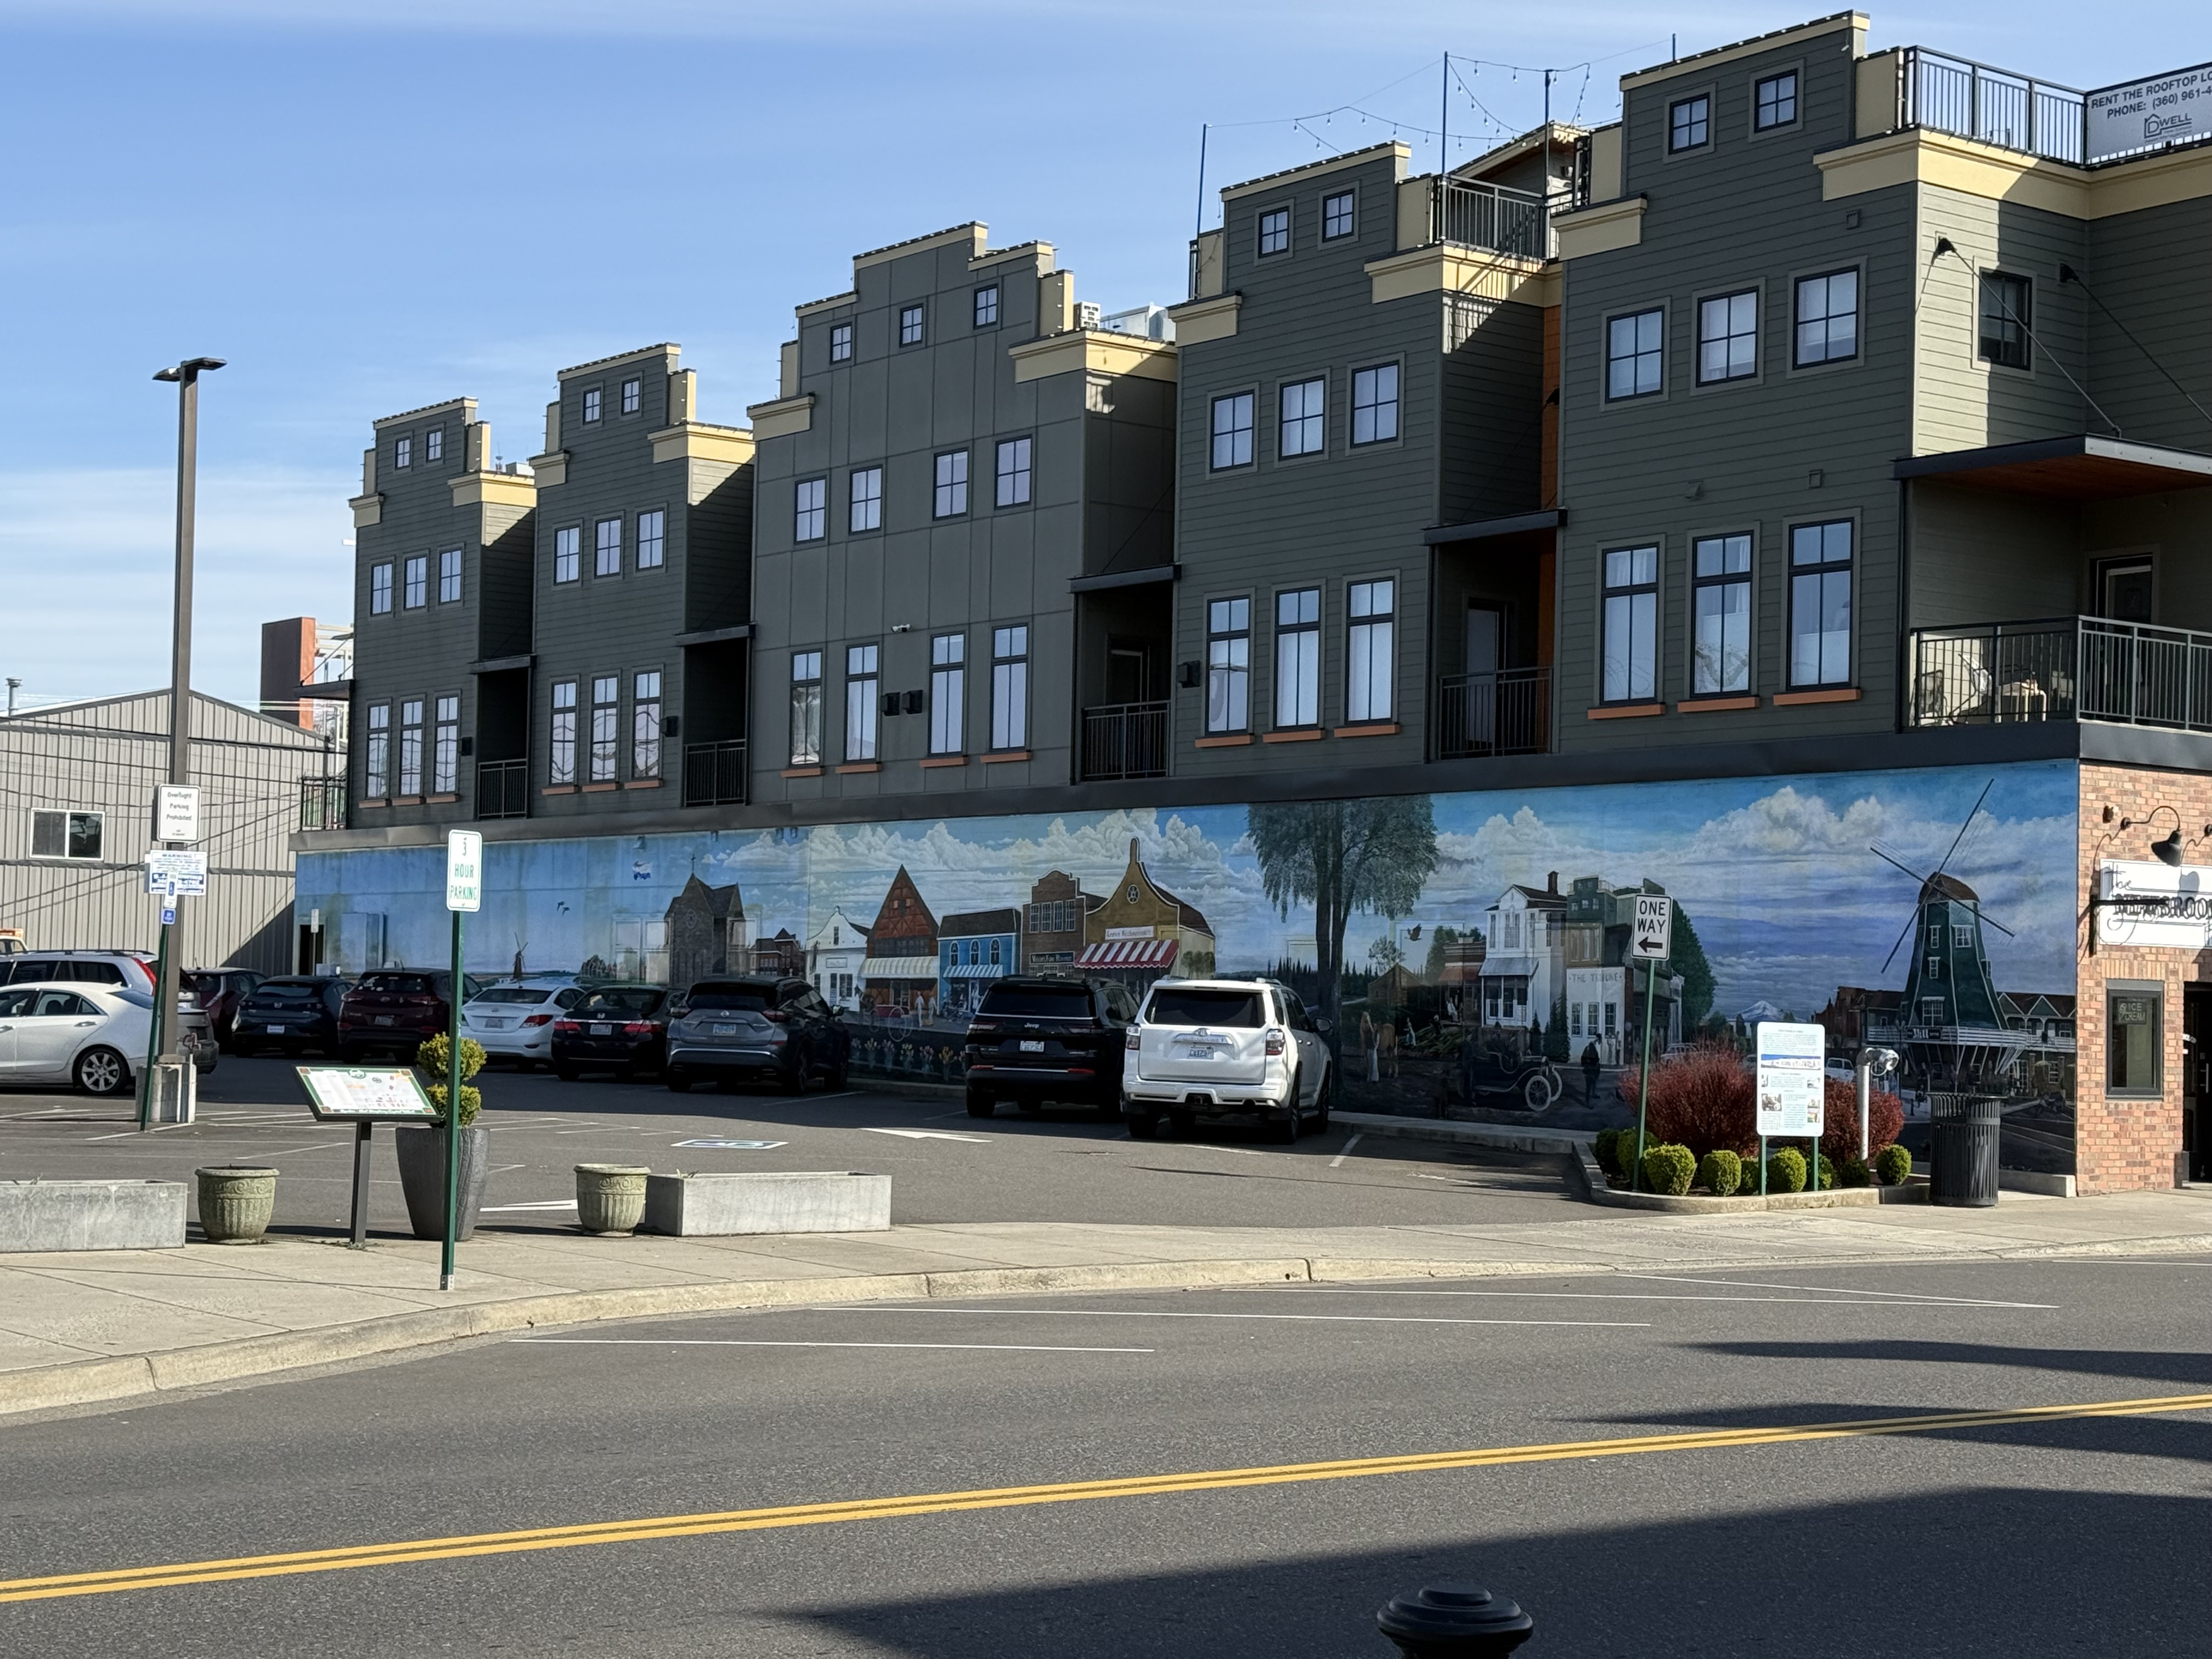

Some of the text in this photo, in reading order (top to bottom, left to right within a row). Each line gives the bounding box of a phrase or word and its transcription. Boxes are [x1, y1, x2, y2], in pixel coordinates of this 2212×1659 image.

[2091, 94, 2119, 109] RENT
[2123, 88, 2143, 101] THE
[2146, 75, 2198, 96] ROOFTOP
[2107, 102, 2147, 119] PHONE:
[2152, 93, 2178, 110] (360)
[462, 841, 467, 856] 3
[454, 863, 474, 878] HOUR
[450, 884, 477, 901] PARKING
[1639, 900, 1666, 916] ONE
[1638, 918, 1667, 934] WAY
[2128, 1003, 2142, 1011] ICE
[2125, 1012, 2146, 1022] CREAM
